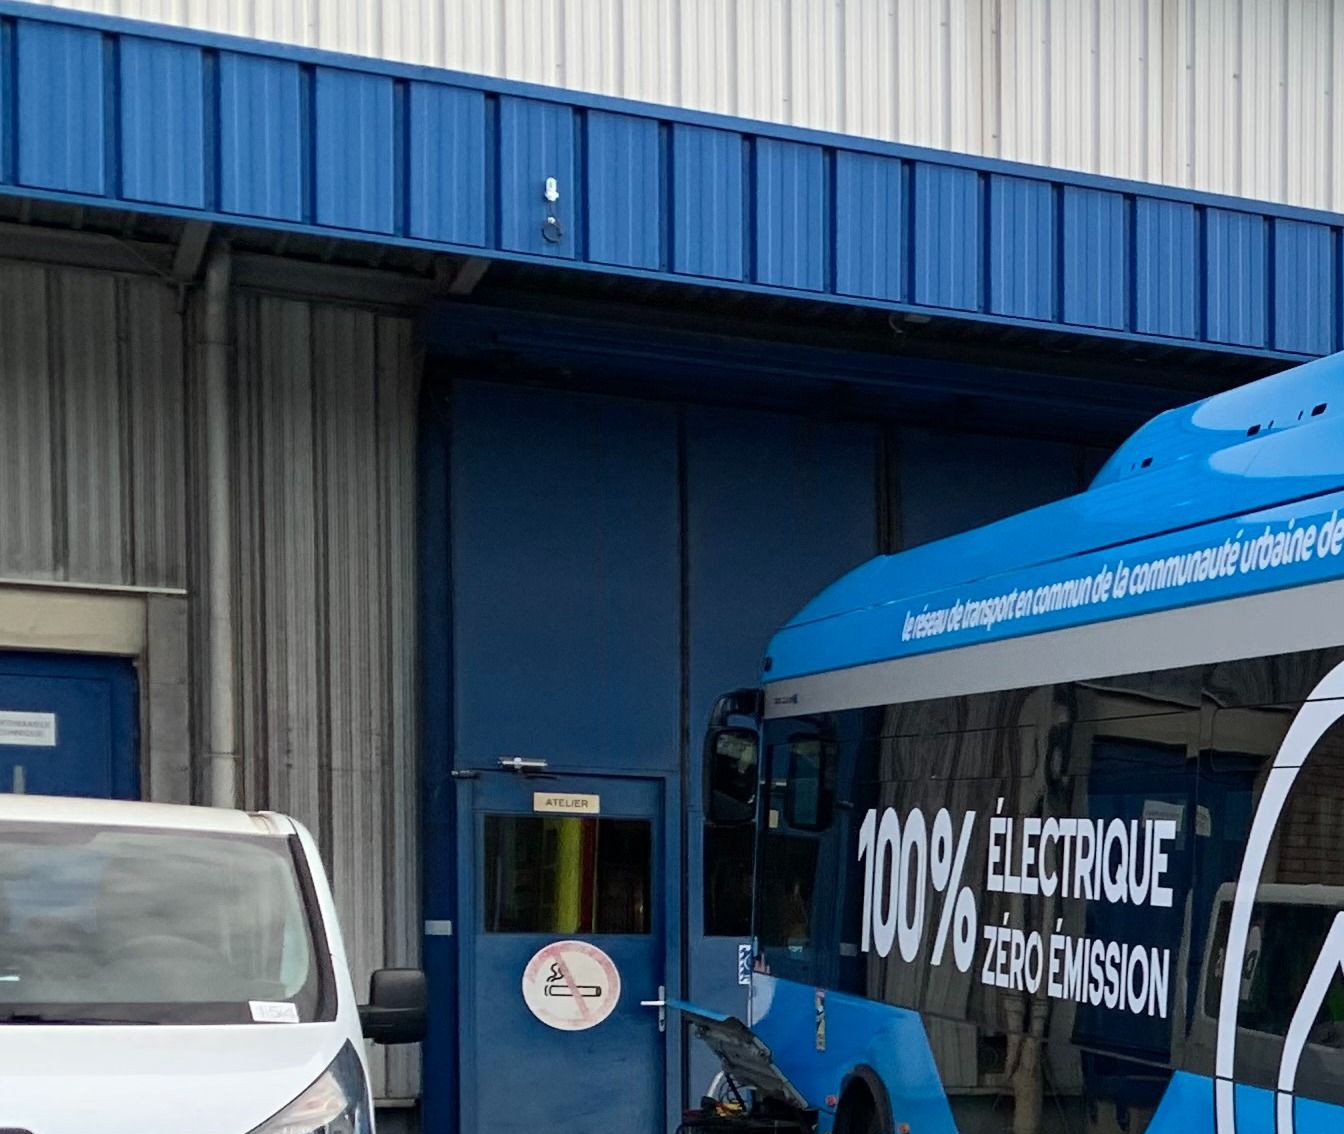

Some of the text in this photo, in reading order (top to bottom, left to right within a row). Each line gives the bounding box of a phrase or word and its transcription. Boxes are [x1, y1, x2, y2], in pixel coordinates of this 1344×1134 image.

[912, 603, 948, 639] réseau
[947, 598, 963, 631] de
[962, 588, 1016, 632] transport
[1015, 588, 1033, 617] en
[1032, 575, 1092, 616] commun
[1091, 563, 1111, 603] de
[1112, 559, 1131, 599] la
[1129, 528, 1243, 596] communauté
[1240, 517, 1317, 574] urbaine
[545, 798, 589, 808] ATELIER
[857, 797, 1177, 973] 100% ÉLECTRIQUE
[981, 911, 1170, 1018] ZÉRO ÉMISSION
